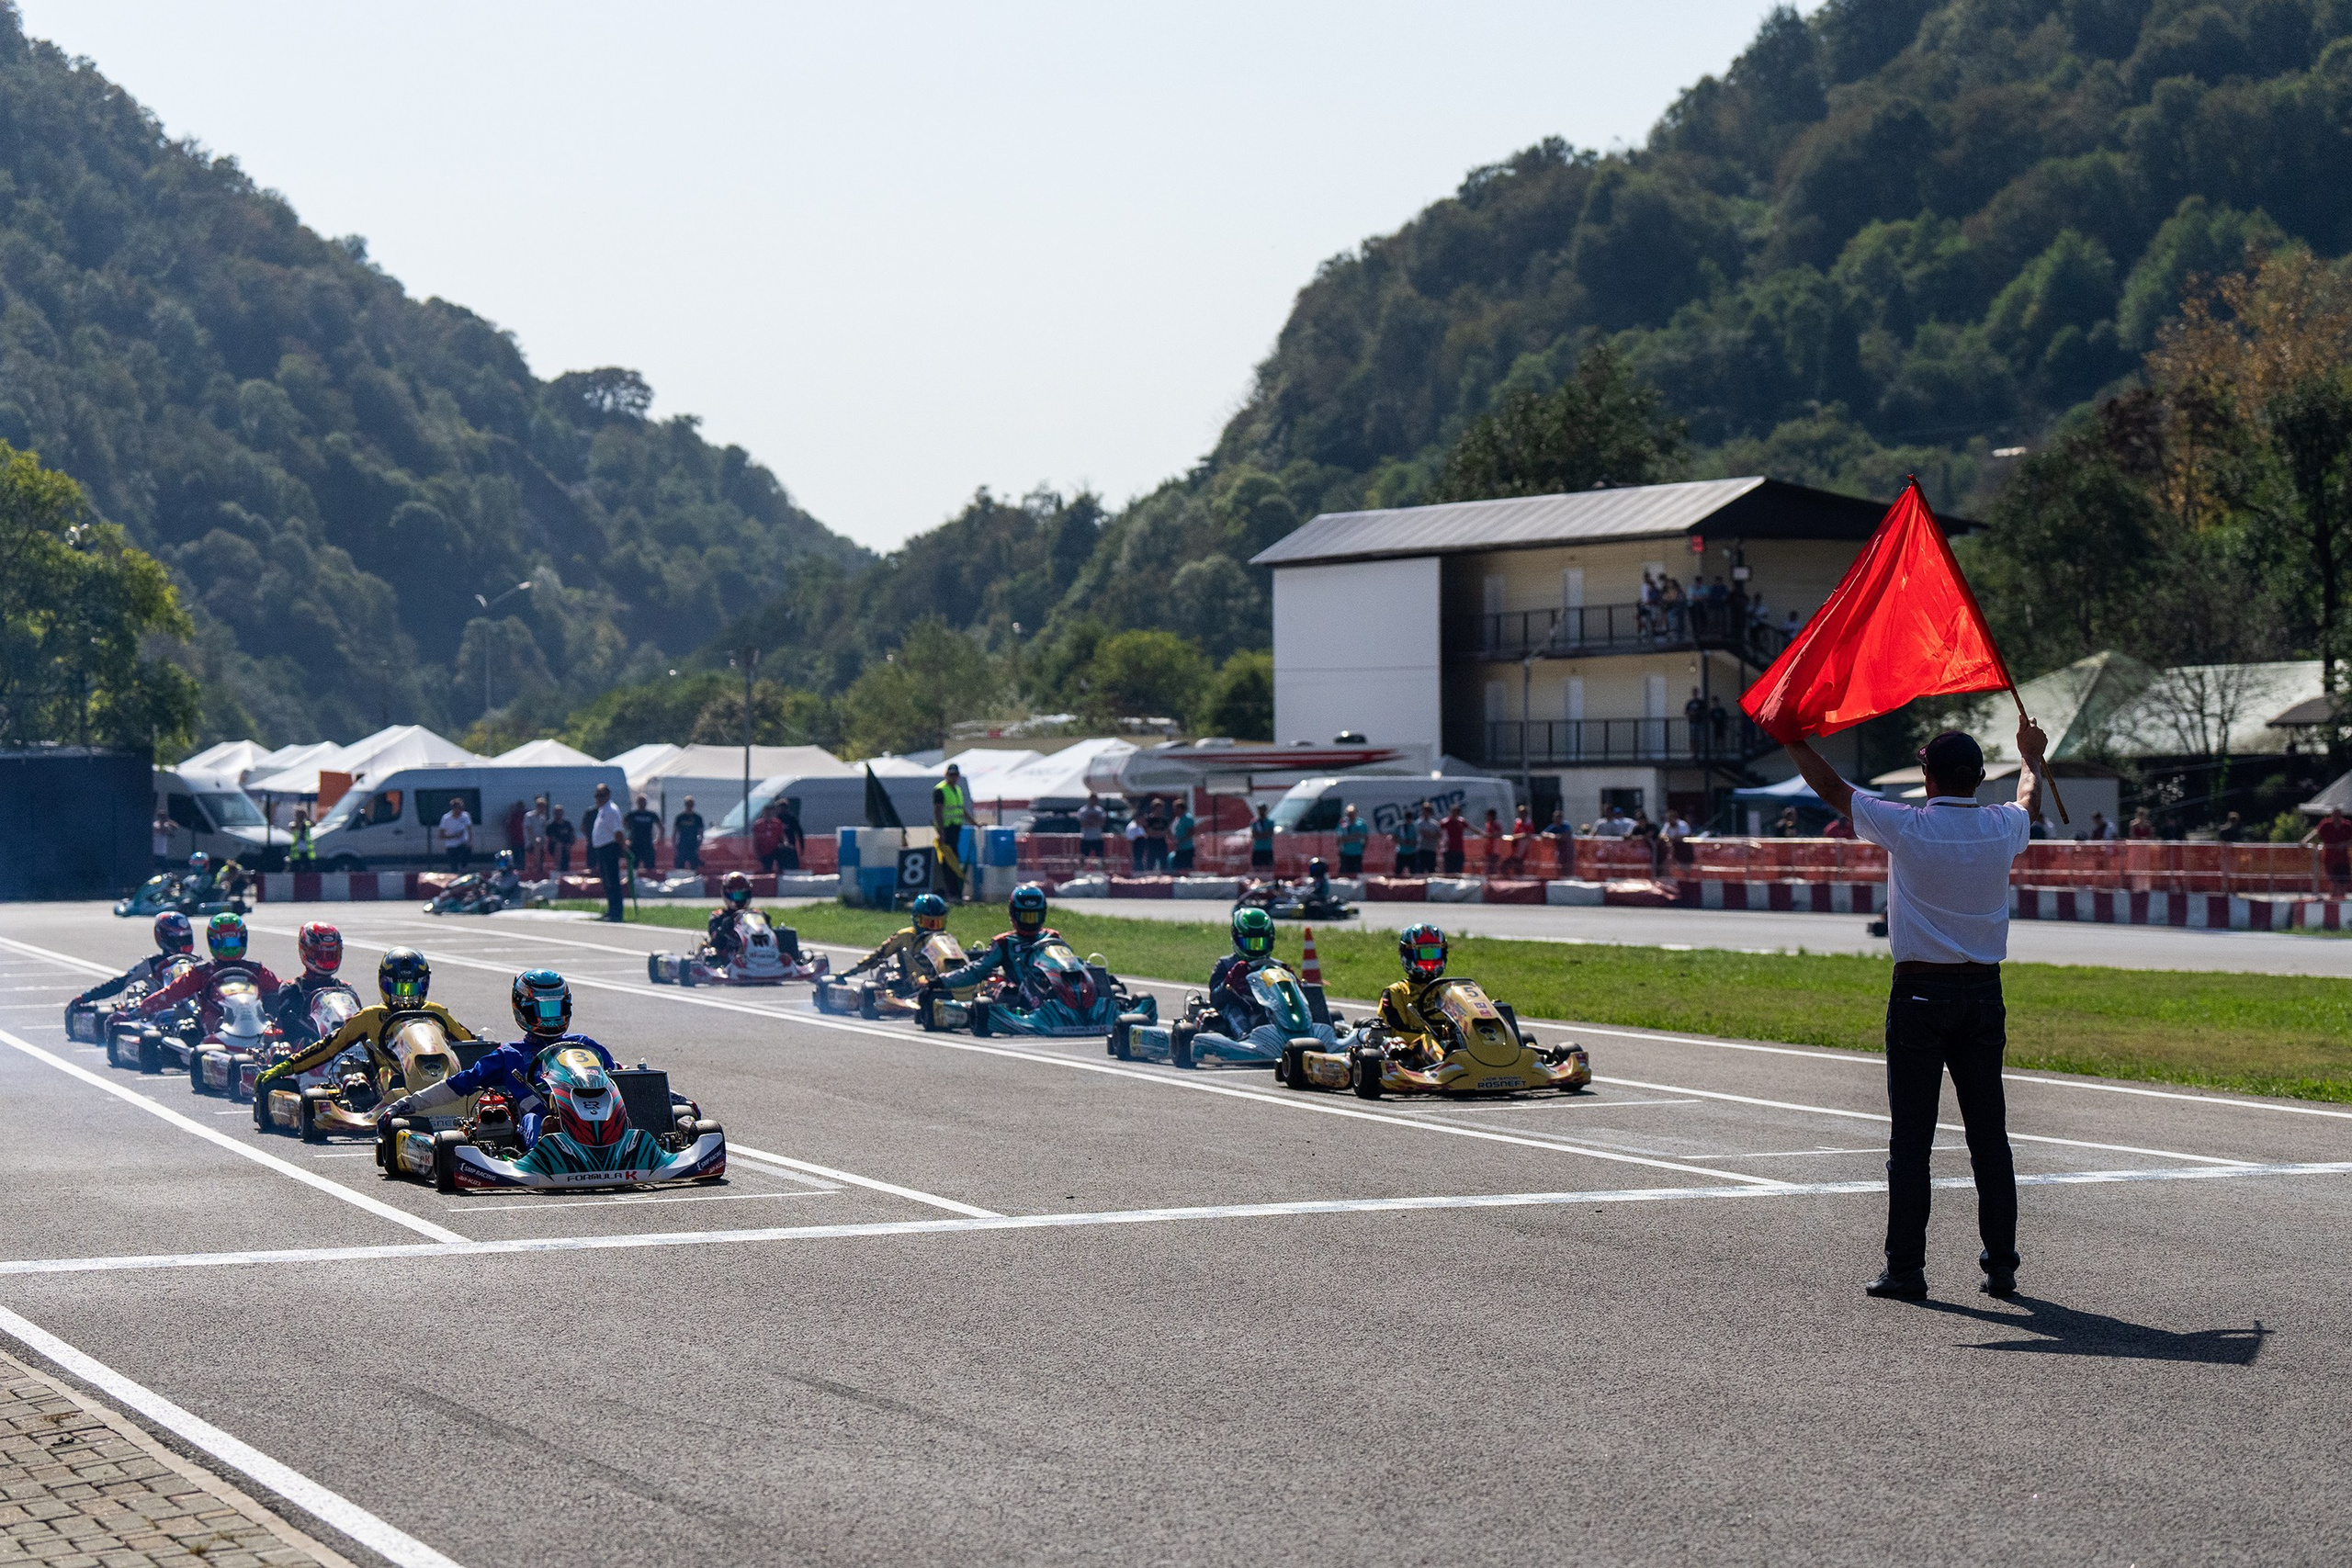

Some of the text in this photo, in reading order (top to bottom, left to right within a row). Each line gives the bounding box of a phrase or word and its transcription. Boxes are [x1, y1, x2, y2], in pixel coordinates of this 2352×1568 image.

[902, 853, 924, 885] 8
[1463, 987, 1479, 998] 5
[571, 1051, 589, 1063] 3
[1477, 1080, 1527, 1089] ROSNEFT
[464, 1166, 476, 1176] SMP
[476, 1169, 497, 1181] RACING
[567, 1170, 638, 1183] FORMULA K
